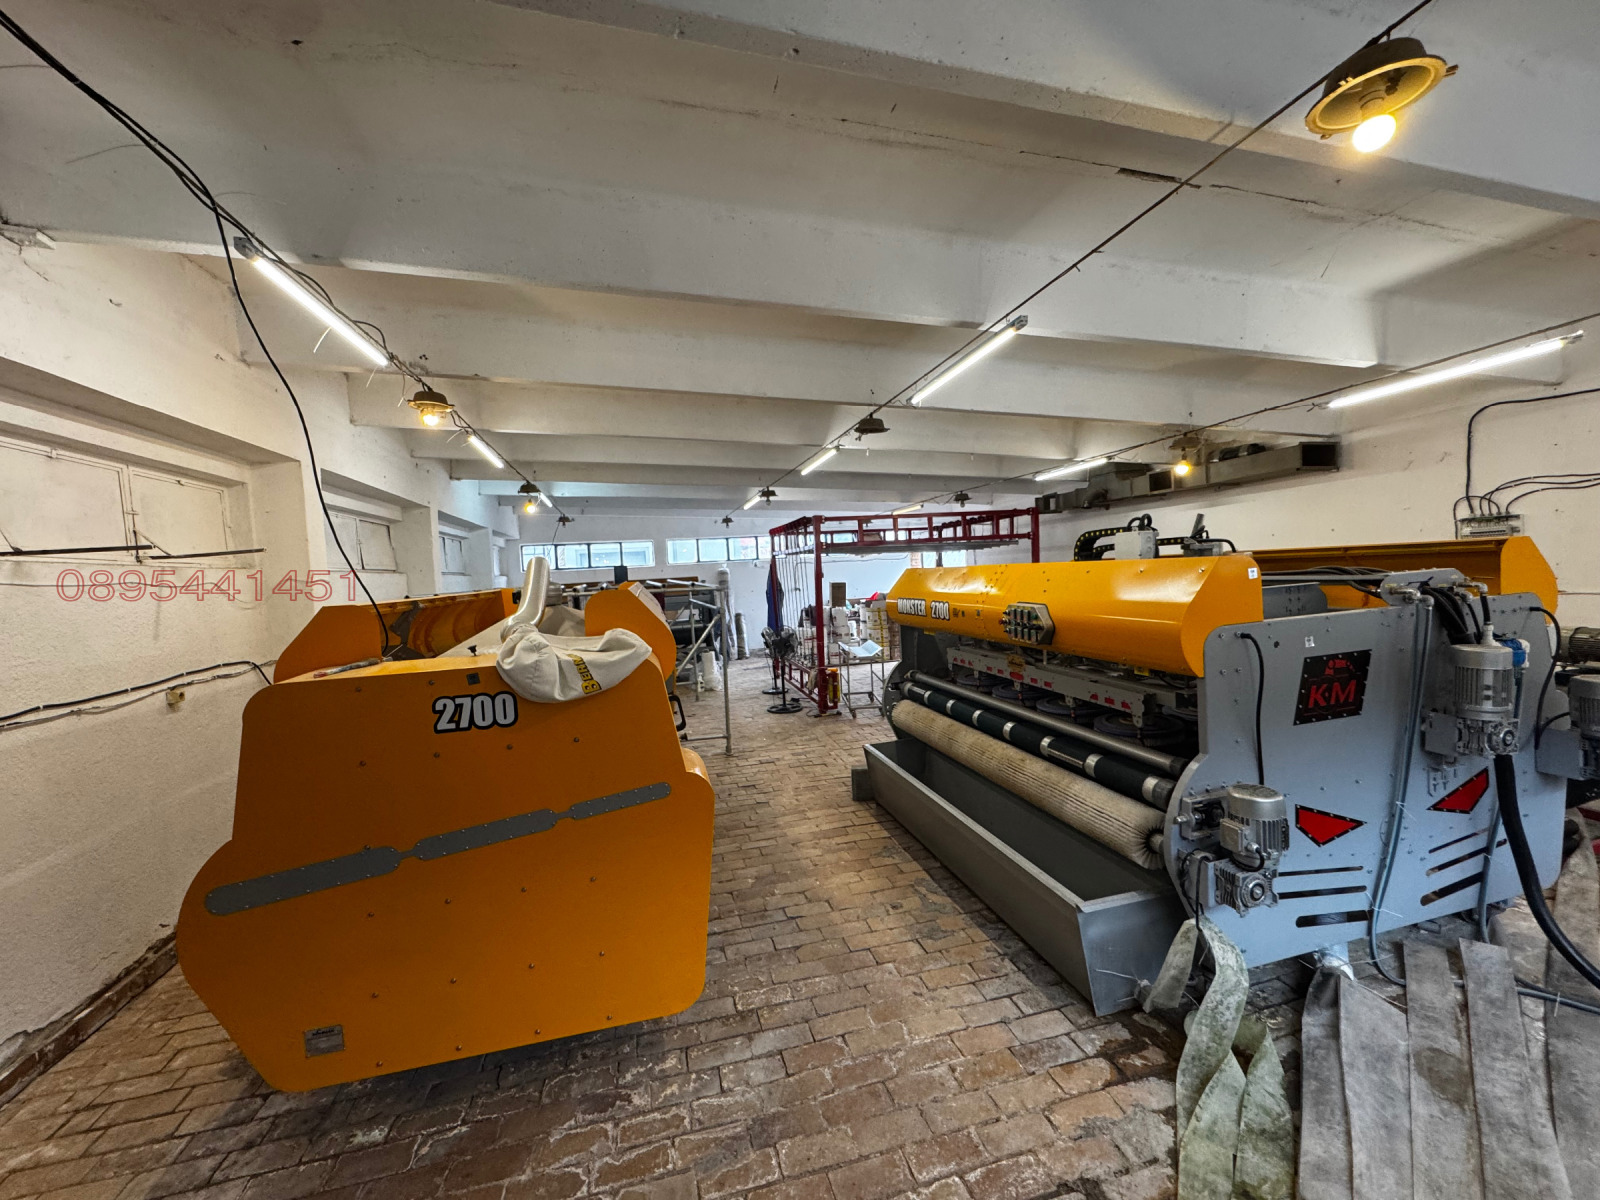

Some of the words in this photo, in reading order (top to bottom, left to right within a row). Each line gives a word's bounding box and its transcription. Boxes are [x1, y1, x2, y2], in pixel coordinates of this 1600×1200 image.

[897, 598, 927, 617] MONSTER
[930, 600, 950, 621] 2700
[433, 691, 518, 733] 2700
